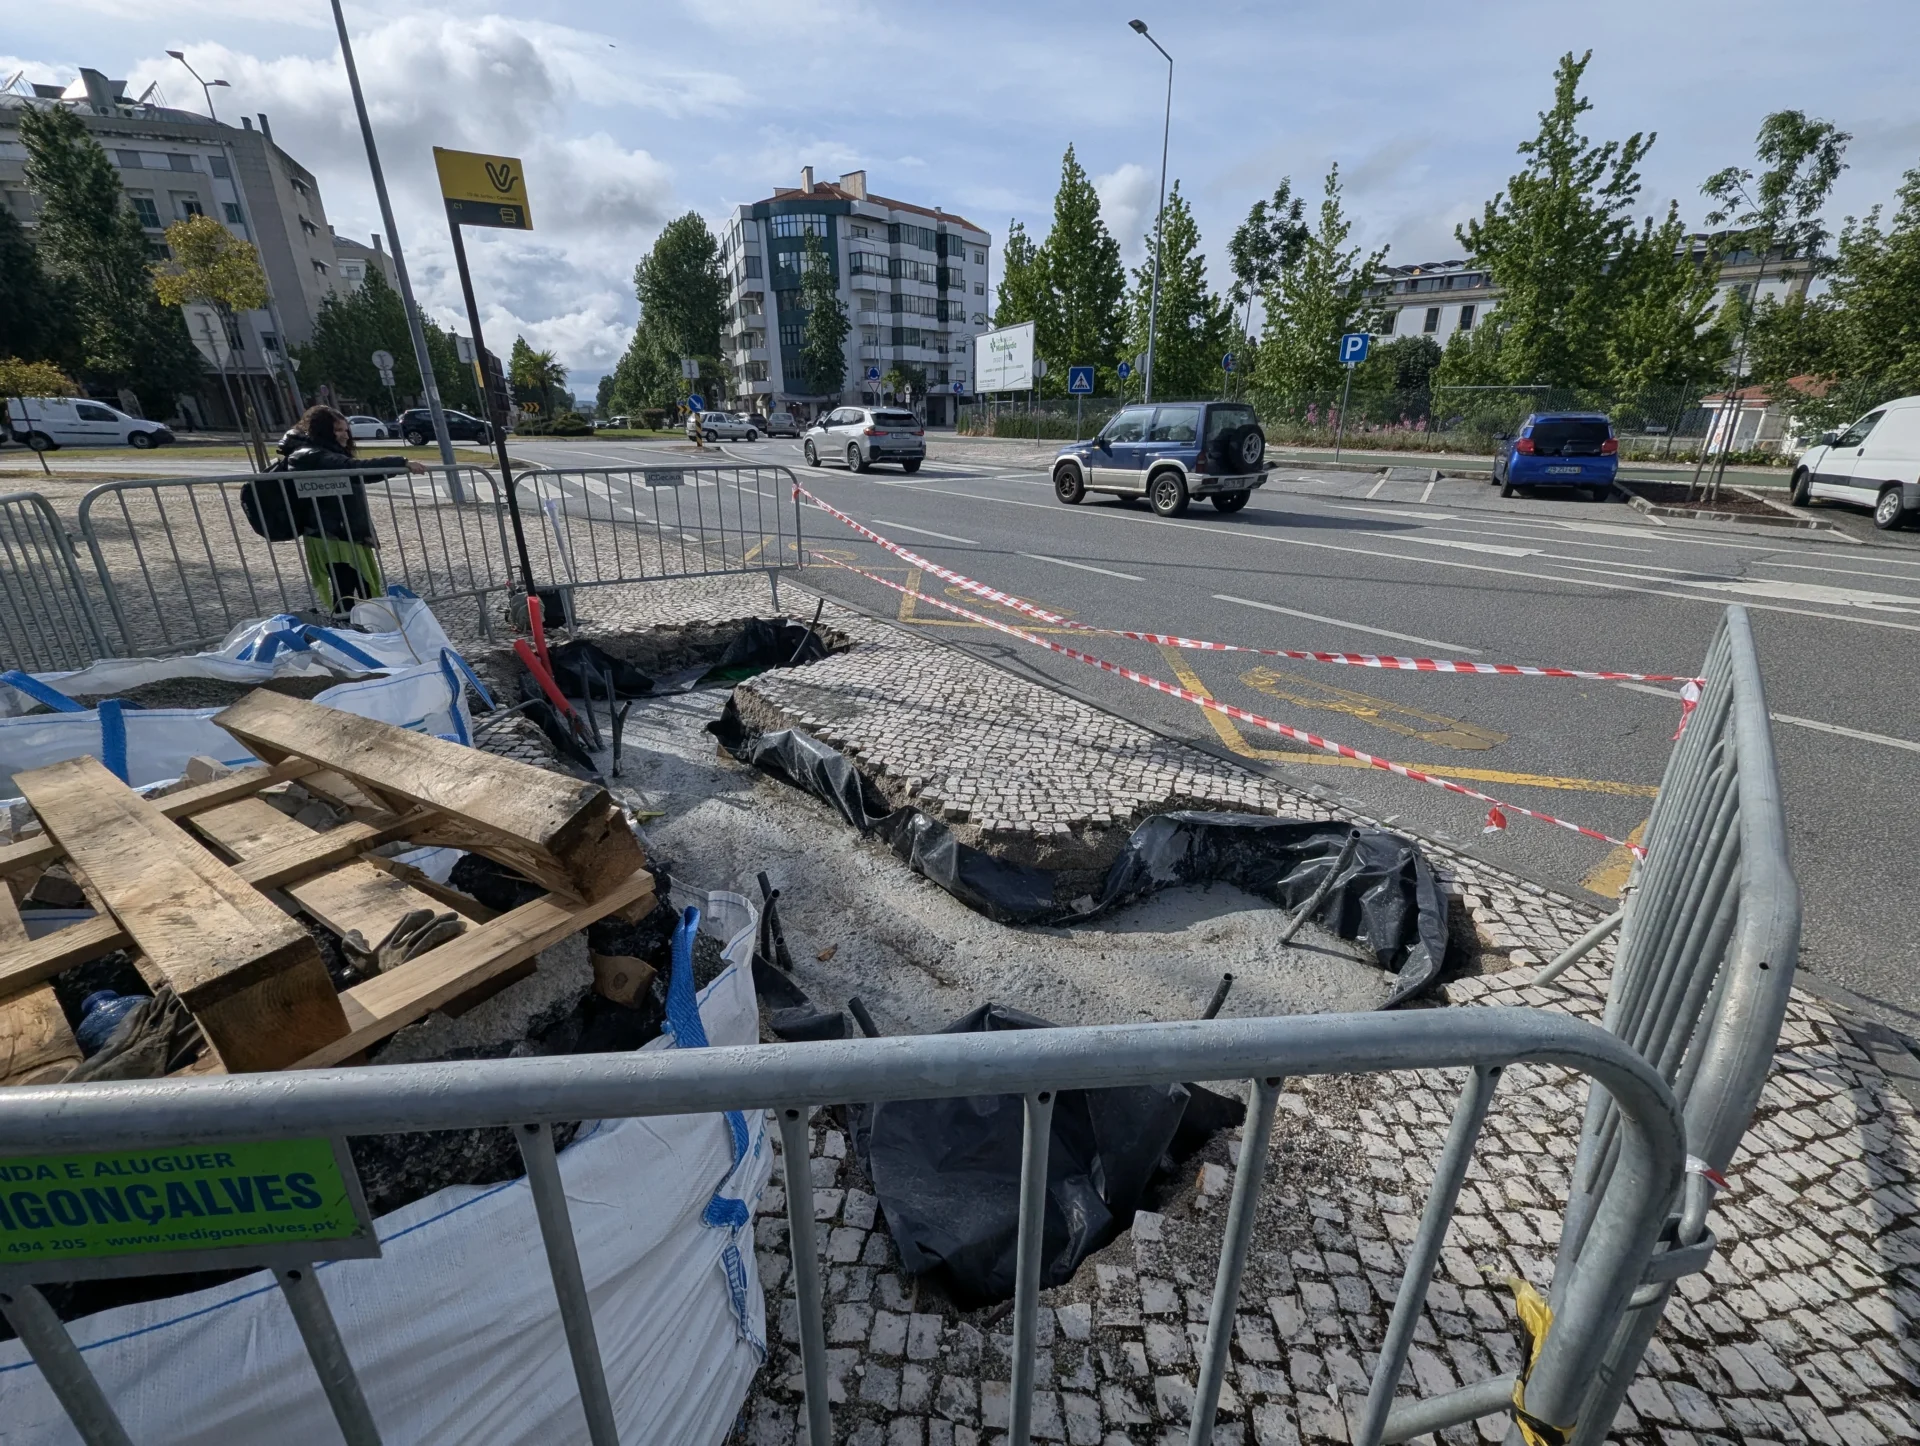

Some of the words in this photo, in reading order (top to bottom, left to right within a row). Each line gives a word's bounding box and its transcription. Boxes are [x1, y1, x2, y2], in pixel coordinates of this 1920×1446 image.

[1345, 336, 1363, 360] P
[297, 480, 348, 492] JCDecaux
[647, 474, 682, 482] JCDecaux
[64, 1163, 85, 1179] E
[93, 1152, 236, 1178] ALUGUER
[8, 1241, 44, 1254] 494
[49, 1238, 88, 1251] 205
[106, 1220, 335, 1246] www.vedigoncalves.pt
